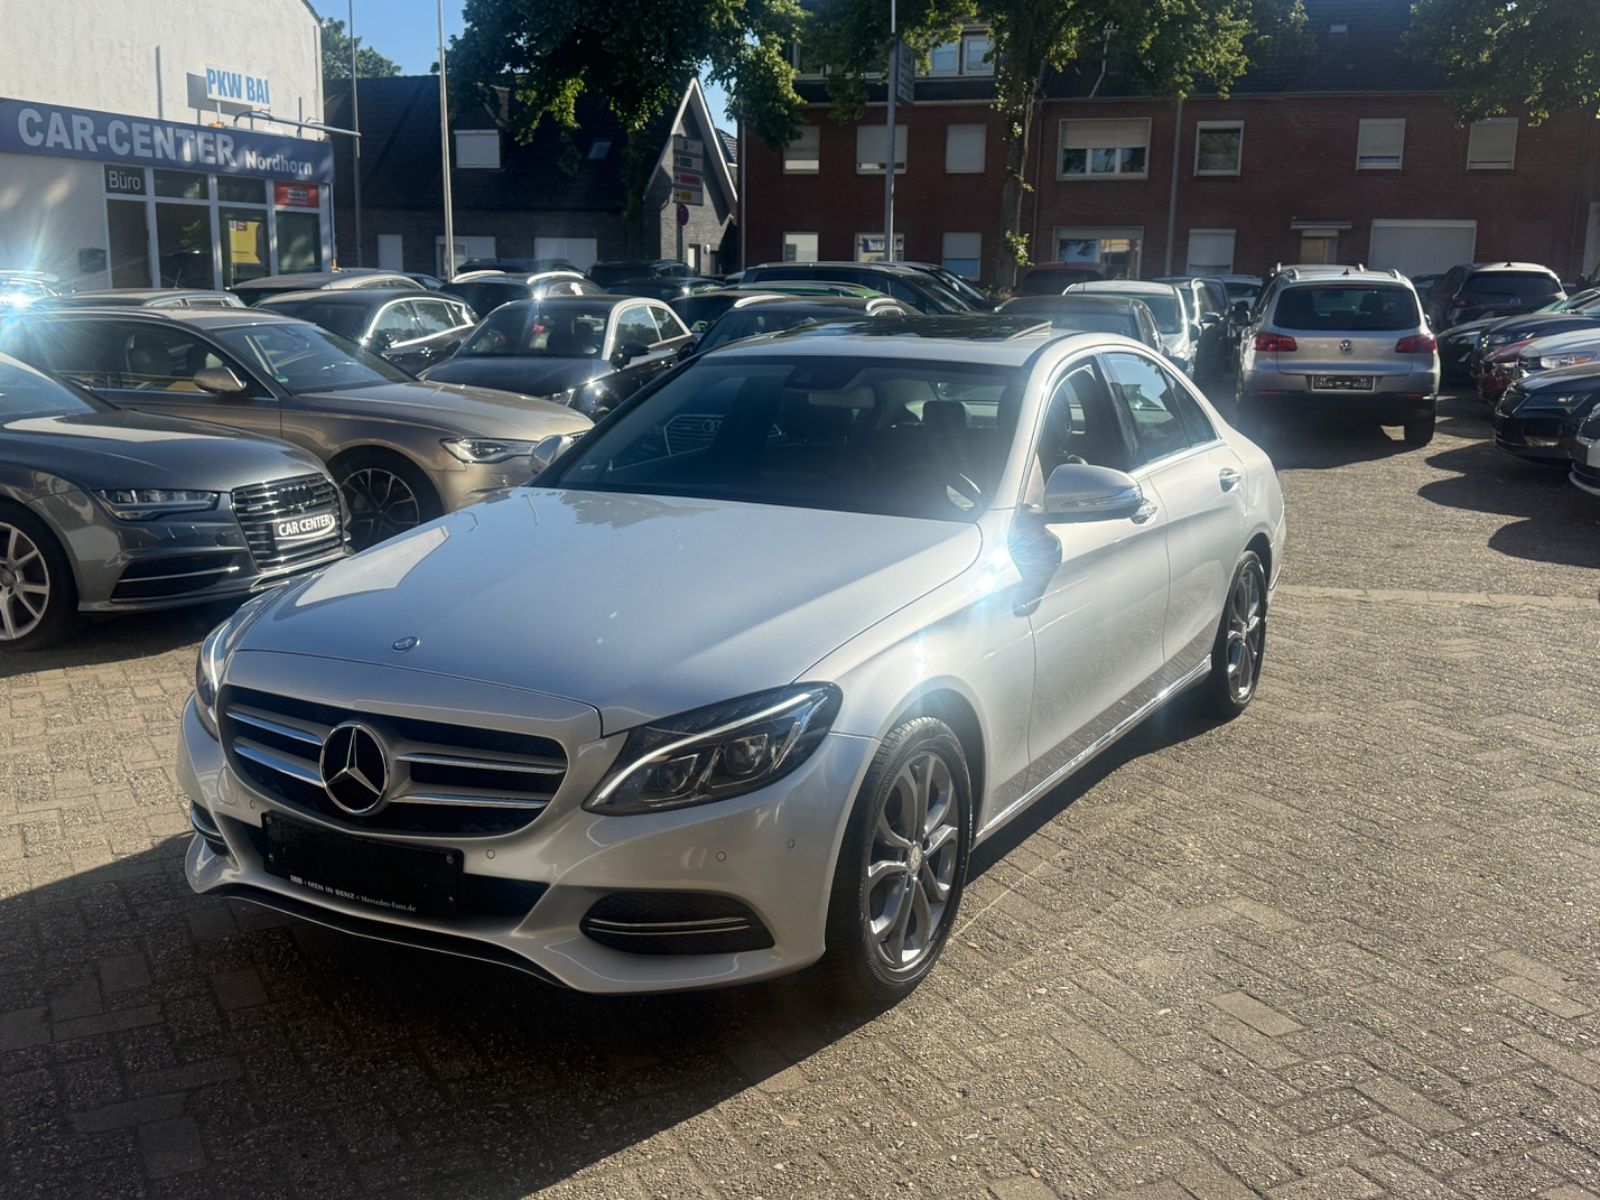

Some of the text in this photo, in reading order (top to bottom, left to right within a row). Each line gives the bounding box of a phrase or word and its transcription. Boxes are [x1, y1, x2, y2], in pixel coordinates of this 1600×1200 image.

[206, 68, 242, 99] PKW
[18, 107, 313, 175] CAR-CENTER Nordhorn
[108, 170, 141, 191] Büro
[278, 514, 330, 536] CAR CENTER
[307, 880, 324, 891] MEN
[325, 886, 334, 895] IN
[335, 889, 355, 900] BENZ
